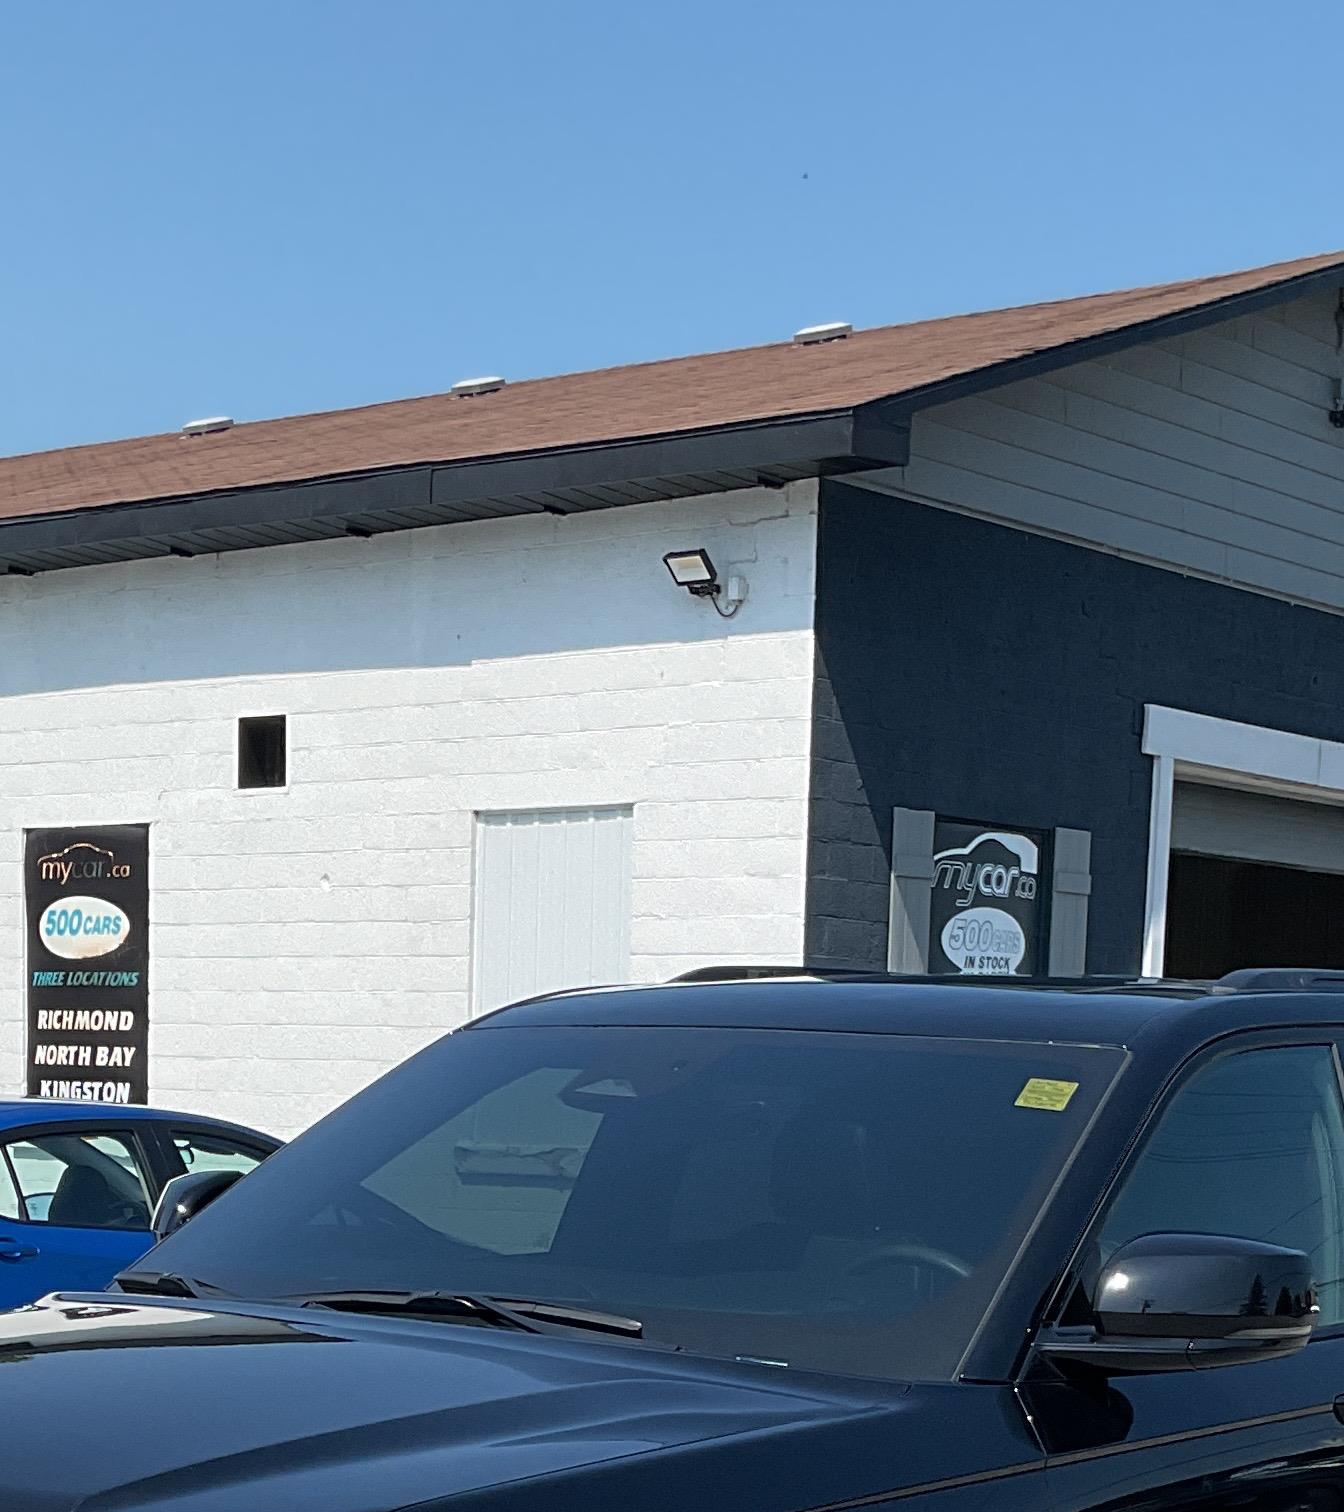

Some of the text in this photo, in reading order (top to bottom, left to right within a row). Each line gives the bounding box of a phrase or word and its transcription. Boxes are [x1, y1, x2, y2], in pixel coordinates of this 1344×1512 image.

[948, 917, 993, 953] 500
[963, 955, 1011, 971] IN STOCK
[32, 971, 140, 987] THREE LOCATIONS
[37, 1009, 135, 1031] RICHMOND
[34, 1044, 136, 1067] NORTH BAY
[40, 1079, 131, 1104] KINGSTON
